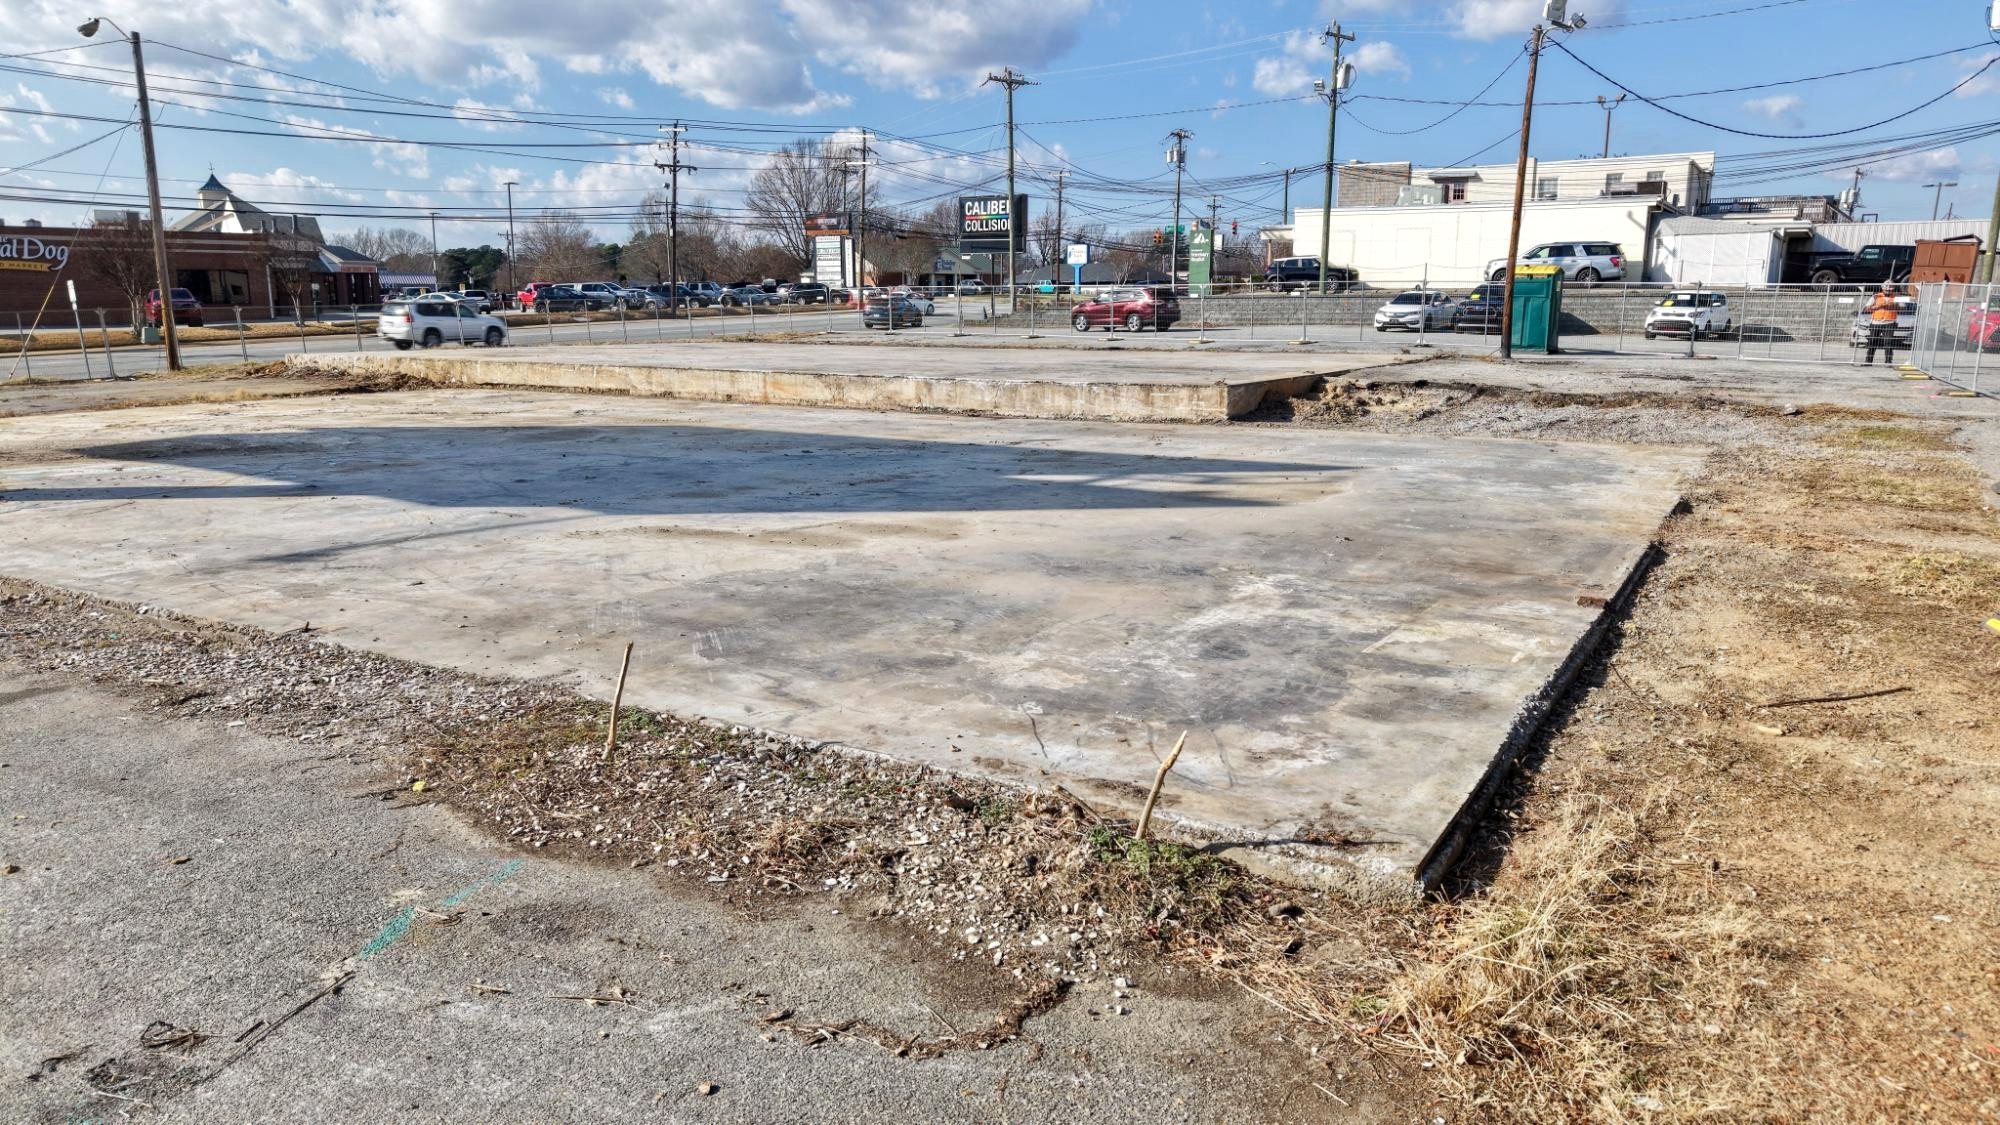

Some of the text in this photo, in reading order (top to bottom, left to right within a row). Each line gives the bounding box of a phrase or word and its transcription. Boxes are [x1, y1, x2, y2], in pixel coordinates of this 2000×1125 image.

[965, 219, 1010, 232] COLLISIO
[0, 237, 69, 270] al Dog
